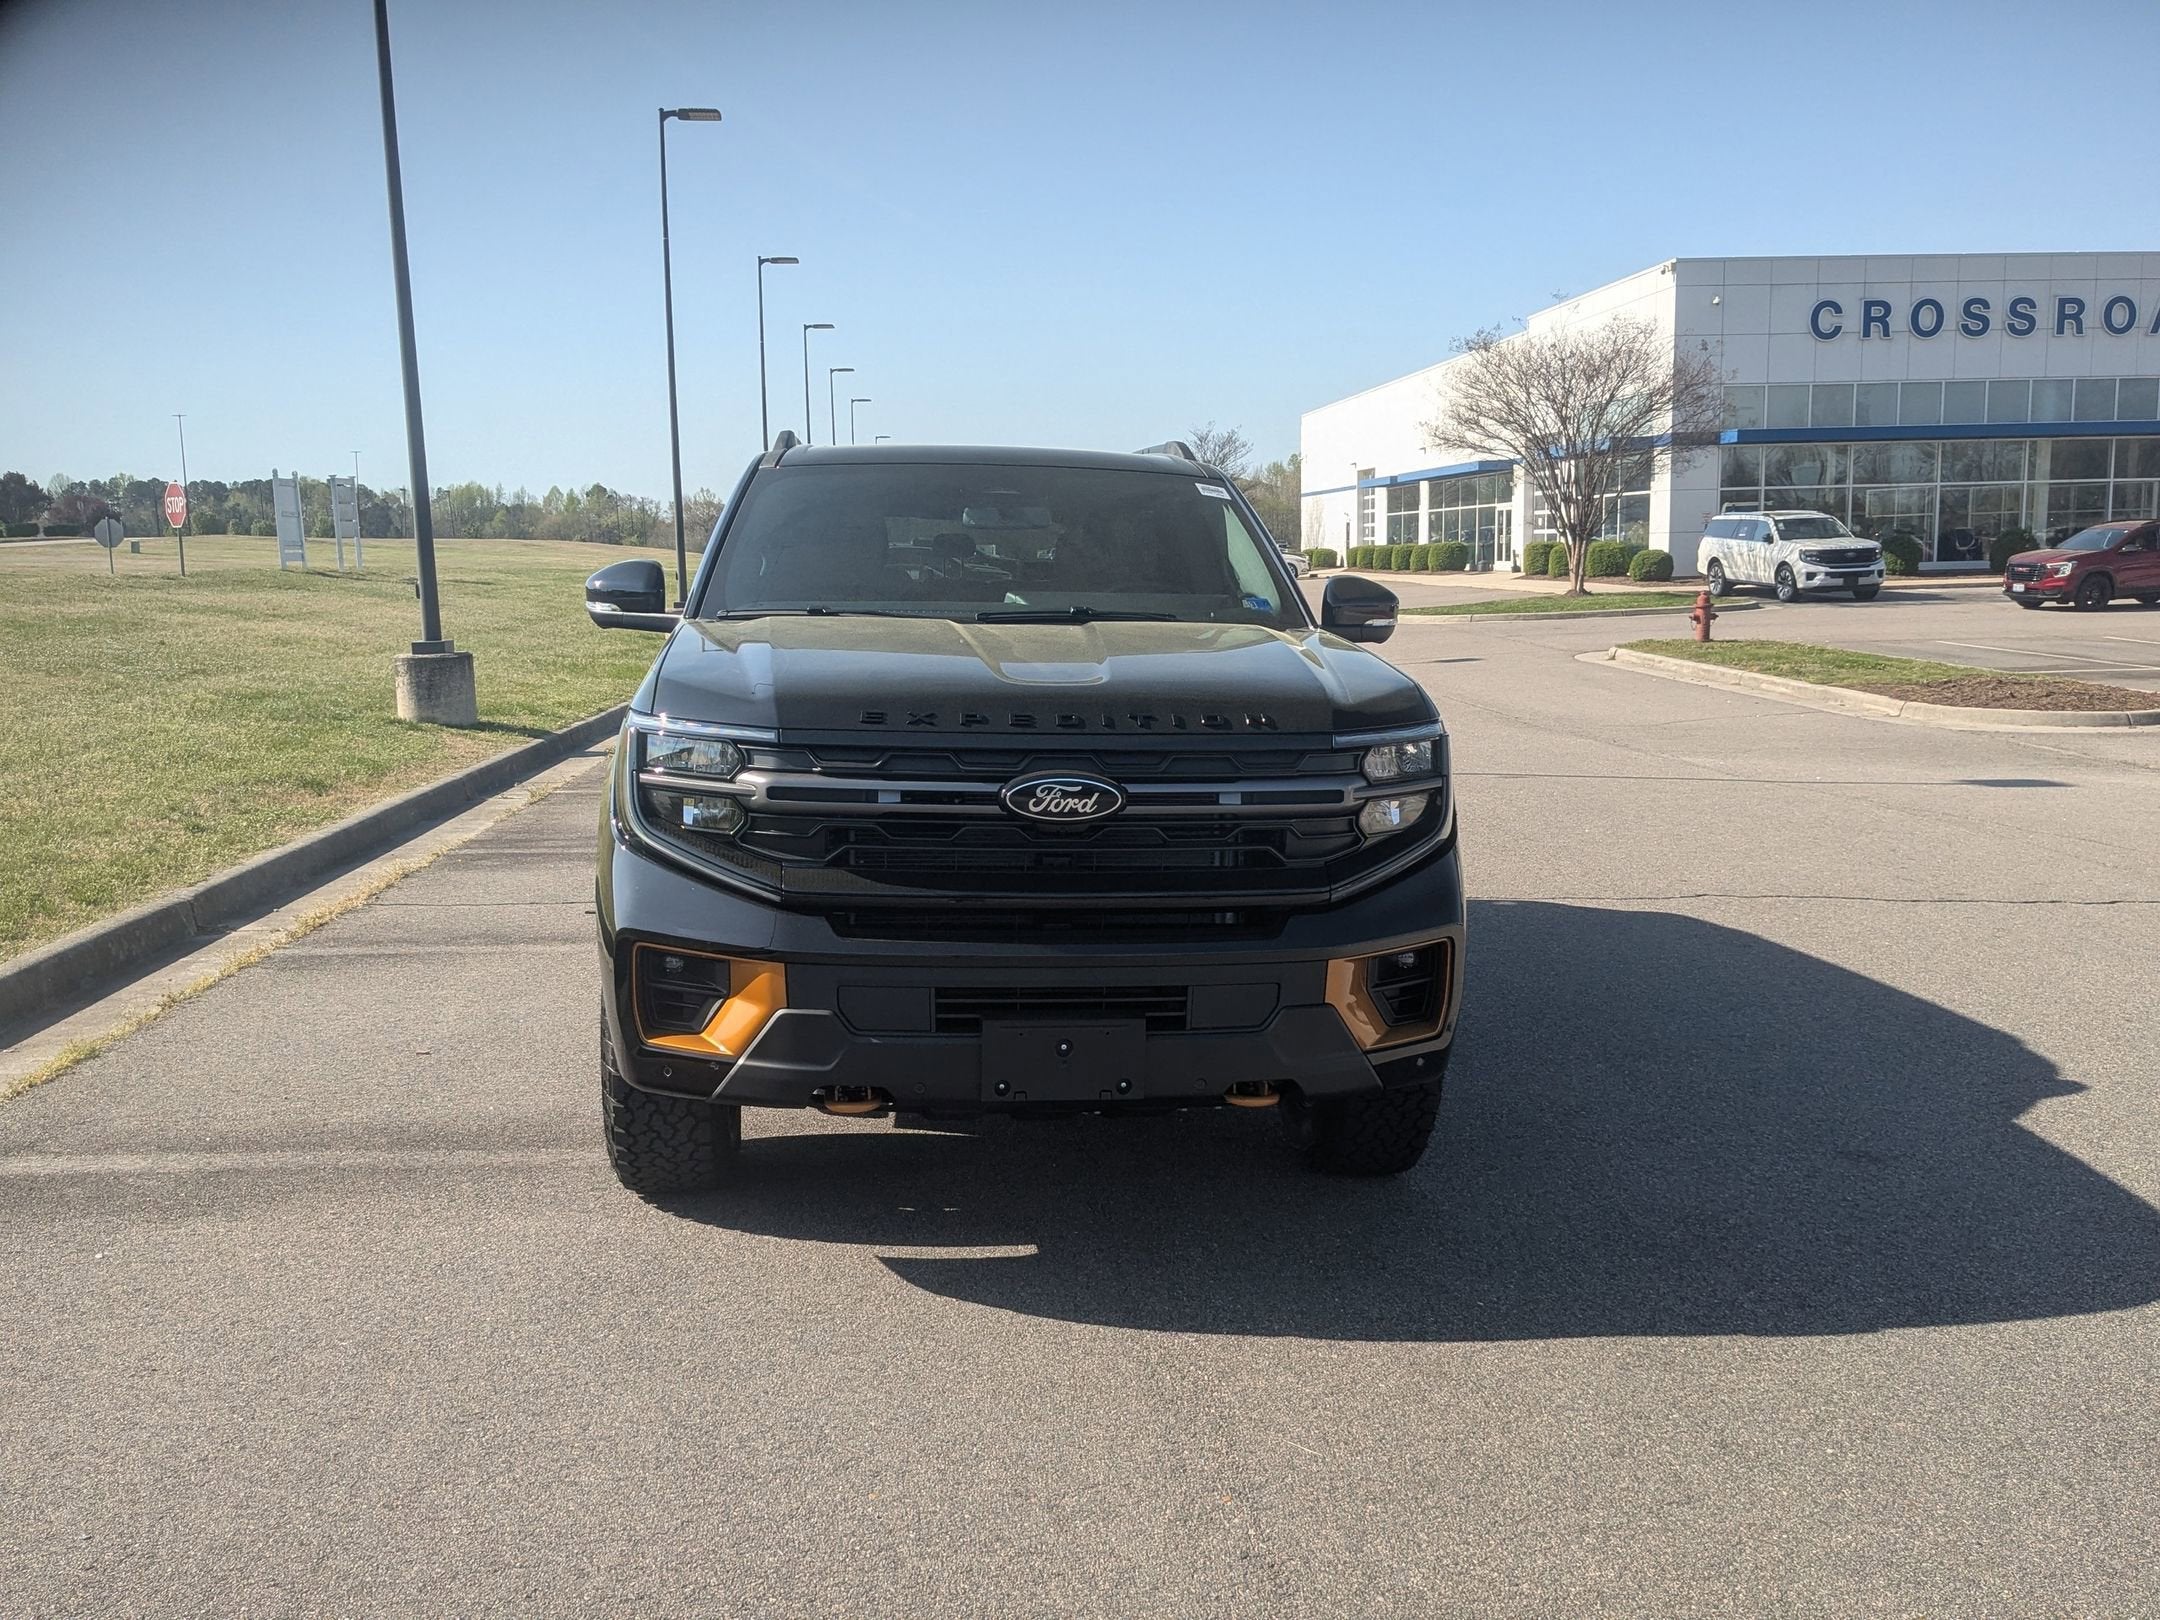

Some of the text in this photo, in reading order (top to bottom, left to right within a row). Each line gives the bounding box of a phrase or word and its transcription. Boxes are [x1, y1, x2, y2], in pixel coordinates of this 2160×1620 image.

[166, 496, 184, 514] STOP
[859, 710, 1276, 728] EXPEDITION
[1028, 784, 1100, 813] Ford
